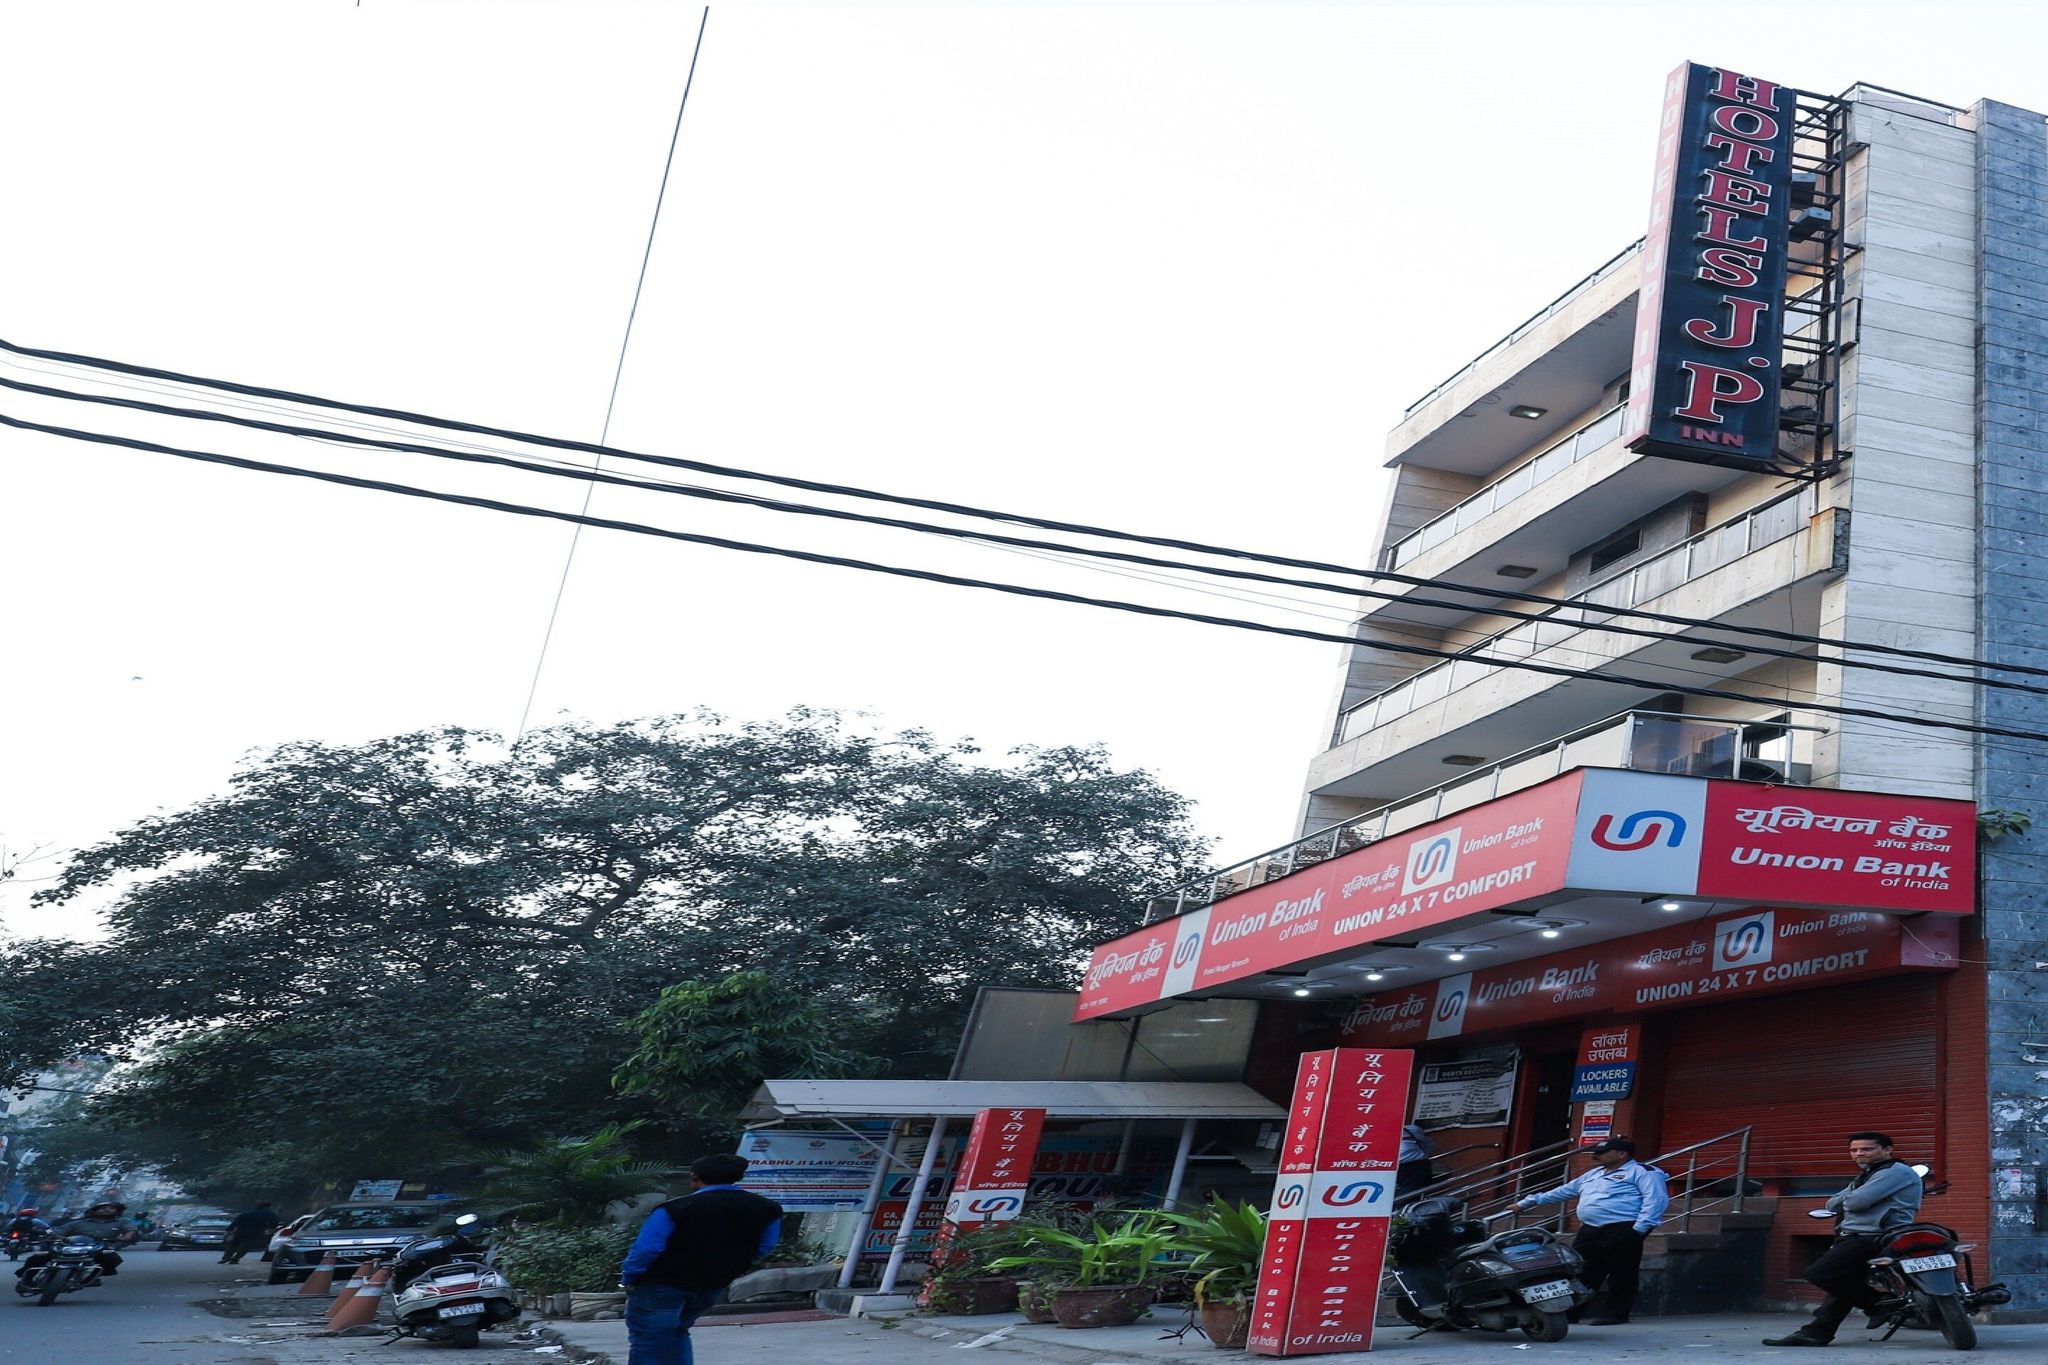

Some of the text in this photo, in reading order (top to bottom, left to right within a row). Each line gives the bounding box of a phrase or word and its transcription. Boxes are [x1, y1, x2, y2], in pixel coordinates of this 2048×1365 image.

[1680, 426, 1744, 447] INN
[1462, 817, 1544, 854] Union Bank
[1735, 806, 1952, 839] यूनियन बैंक
[1873, 839, 1952, 852] ऑफ इंडिया
[1731, 847, 1951, 878] Union Bank
[1342, 864, 1400, 898] यूनियन बैंक
[1881, 878, 1949, 890] of India
[1333, 861, 1537, 935] UNION 24 X 7 COMFORT
[1211, 887, 1327, 946] Union Bank
[1279, 918, 1318, 941] of India
[1779, 911, 1868, 938] Union Bank
[1685, 941, 1708, 956] बैंक
[1089, 938, 1167, 991] यूनियन बैंक
[1636, 949, 1869, 1004] UNION 24 X 7 COMFORT
[1476, 960, 1600, 1007] Union Bank
[1552, 986, 1596, 1004] of India
[1340, 993, 1428, 1036] यूनियन बैंक
[1592, 1028, 1628, 1048] लॉकर्स
[1588, 1047, 1628, 1061] उपलब्ध
[1576, 1082, 1629, 1094] AVAILABLE
[1581, 1069, 1628, 1081] LOCKERS
[1294, 1056, 1321, 1155] यूनियन बैंक
[1348, 1053, 1385, 1153] यूनियन बैंक
[992, 1110, 1026, 1177] यूनियन बैंक
[1331, 1160, 1393, 1168] ऑफ इंडिया
[1262, 1225, 1291, 1329] Union Bank
[1320, 1222, 1361, 1327] Union Bank
[1260, 1335, 1279, 1347] India
[1292, 1333, 1362, 1345] of India
